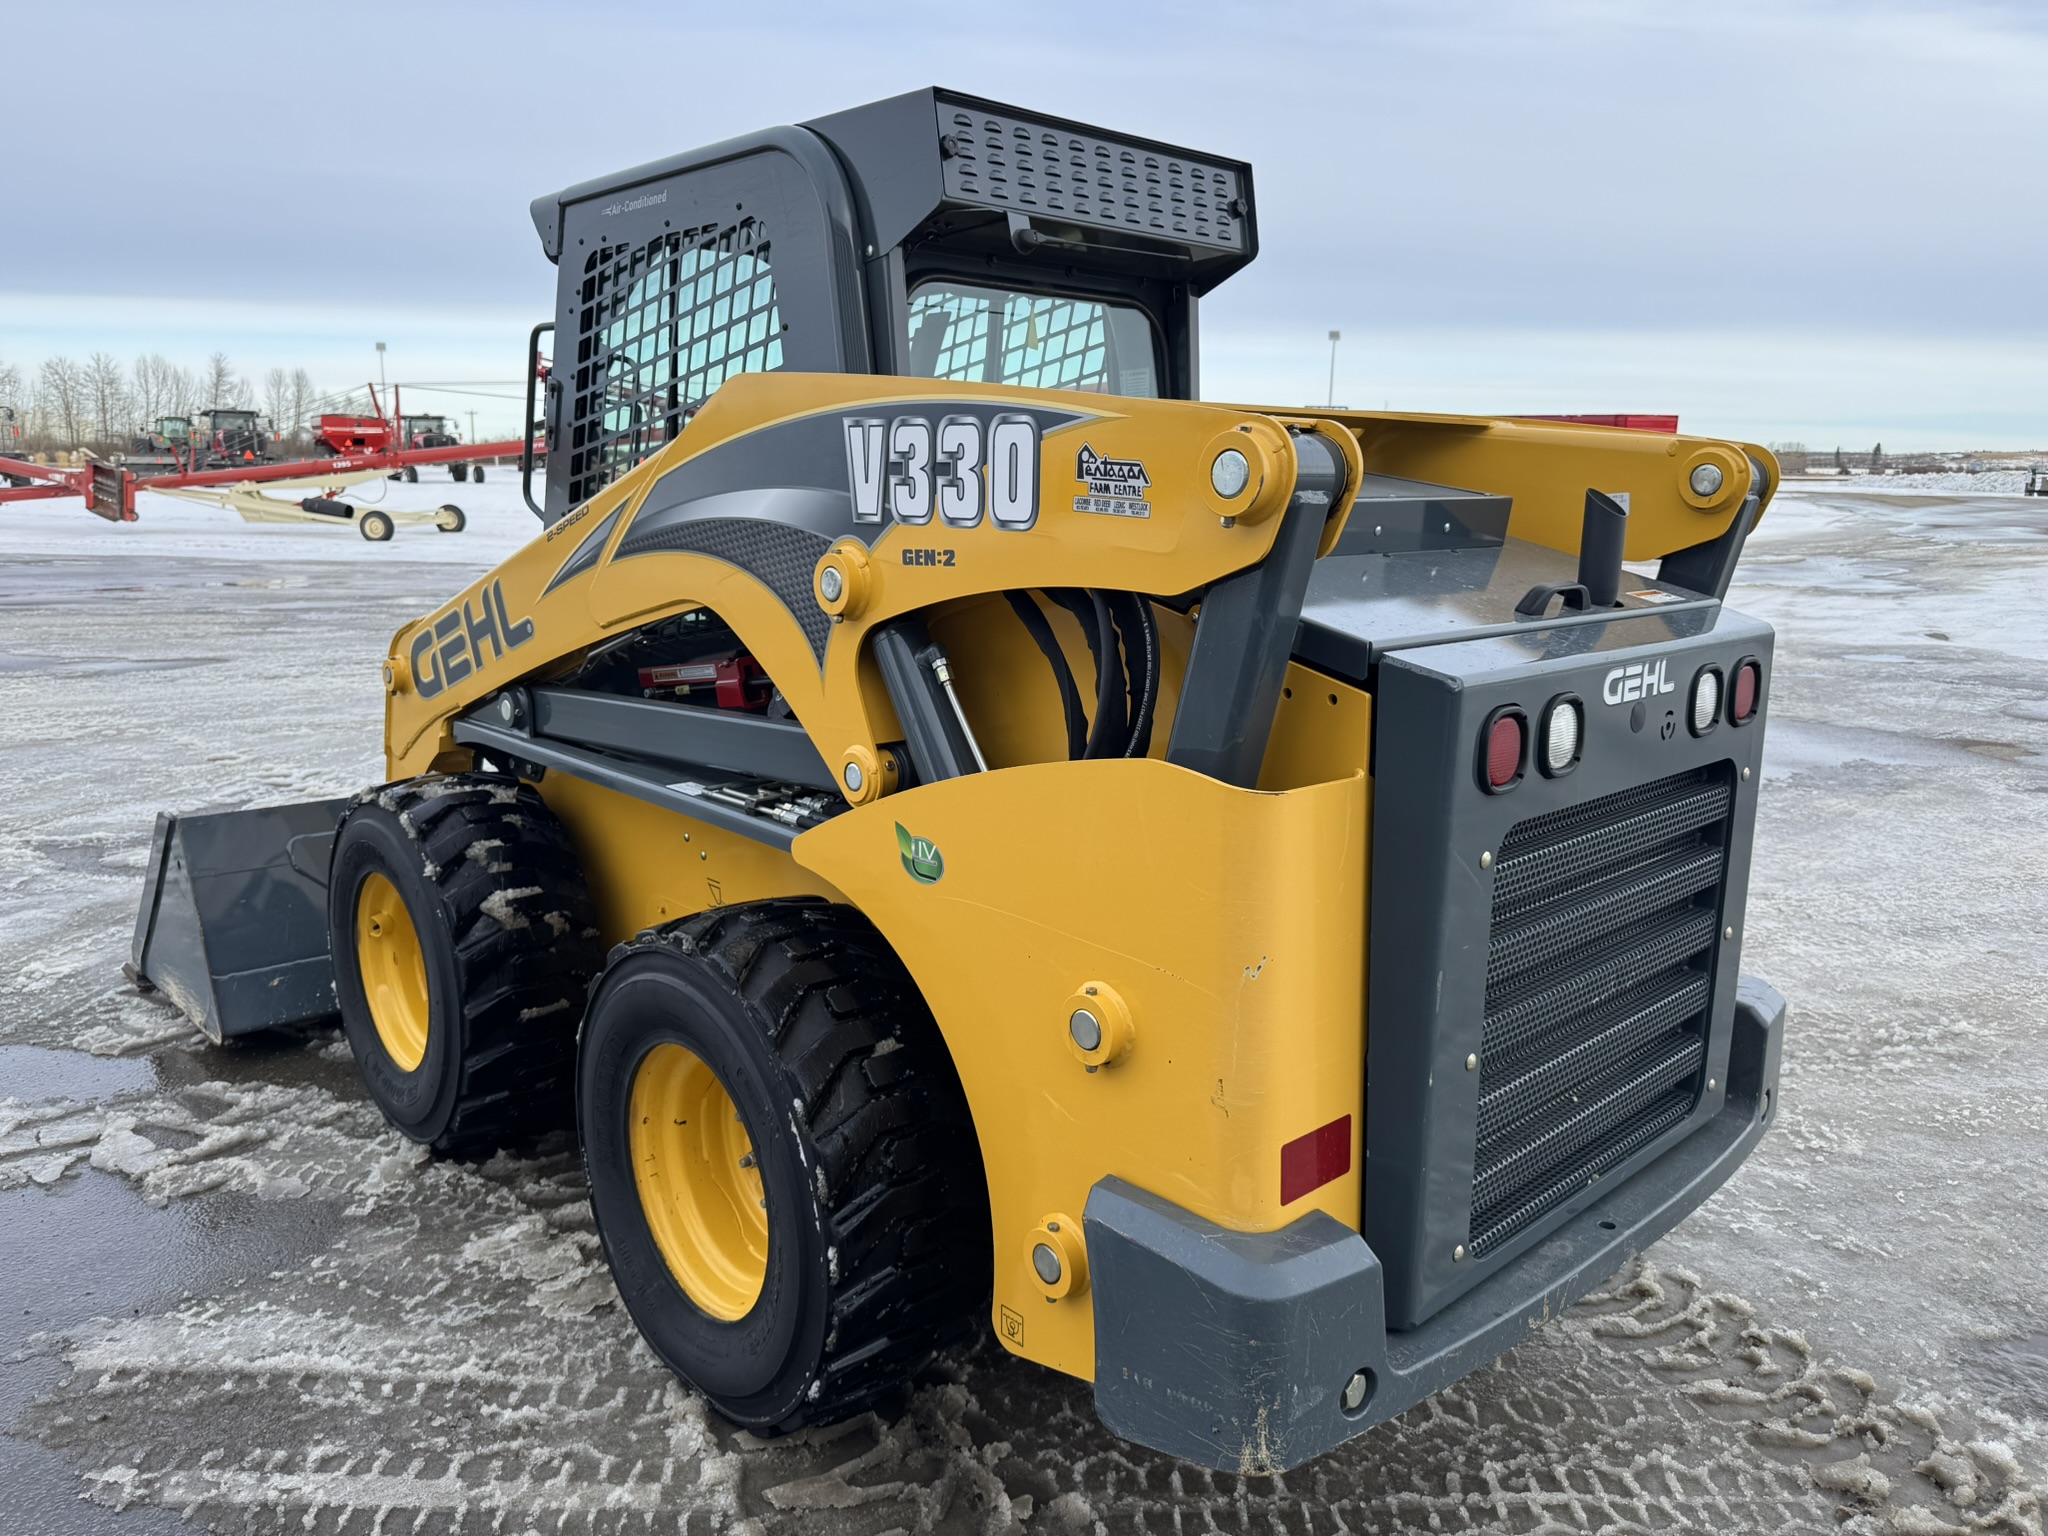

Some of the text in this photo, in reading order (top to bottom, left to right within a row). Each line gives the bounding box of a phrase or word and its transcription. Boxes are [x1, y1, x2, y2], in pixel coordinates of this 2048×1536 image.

[611, 190, 667, 215] Air-Conditioned
[843, 413, 1042, 531] V330
[1077, 444, 1150, 485] Pentagon
[1089, 482, 1142, 497] FARM CENTRE
[546, 505, 590, 542] 2-SPEED
[902, 549, 956, 567] GEN:2
[411, 576, 535, 700] GEHL
[1603, 658, 1675, 706] GEHL
